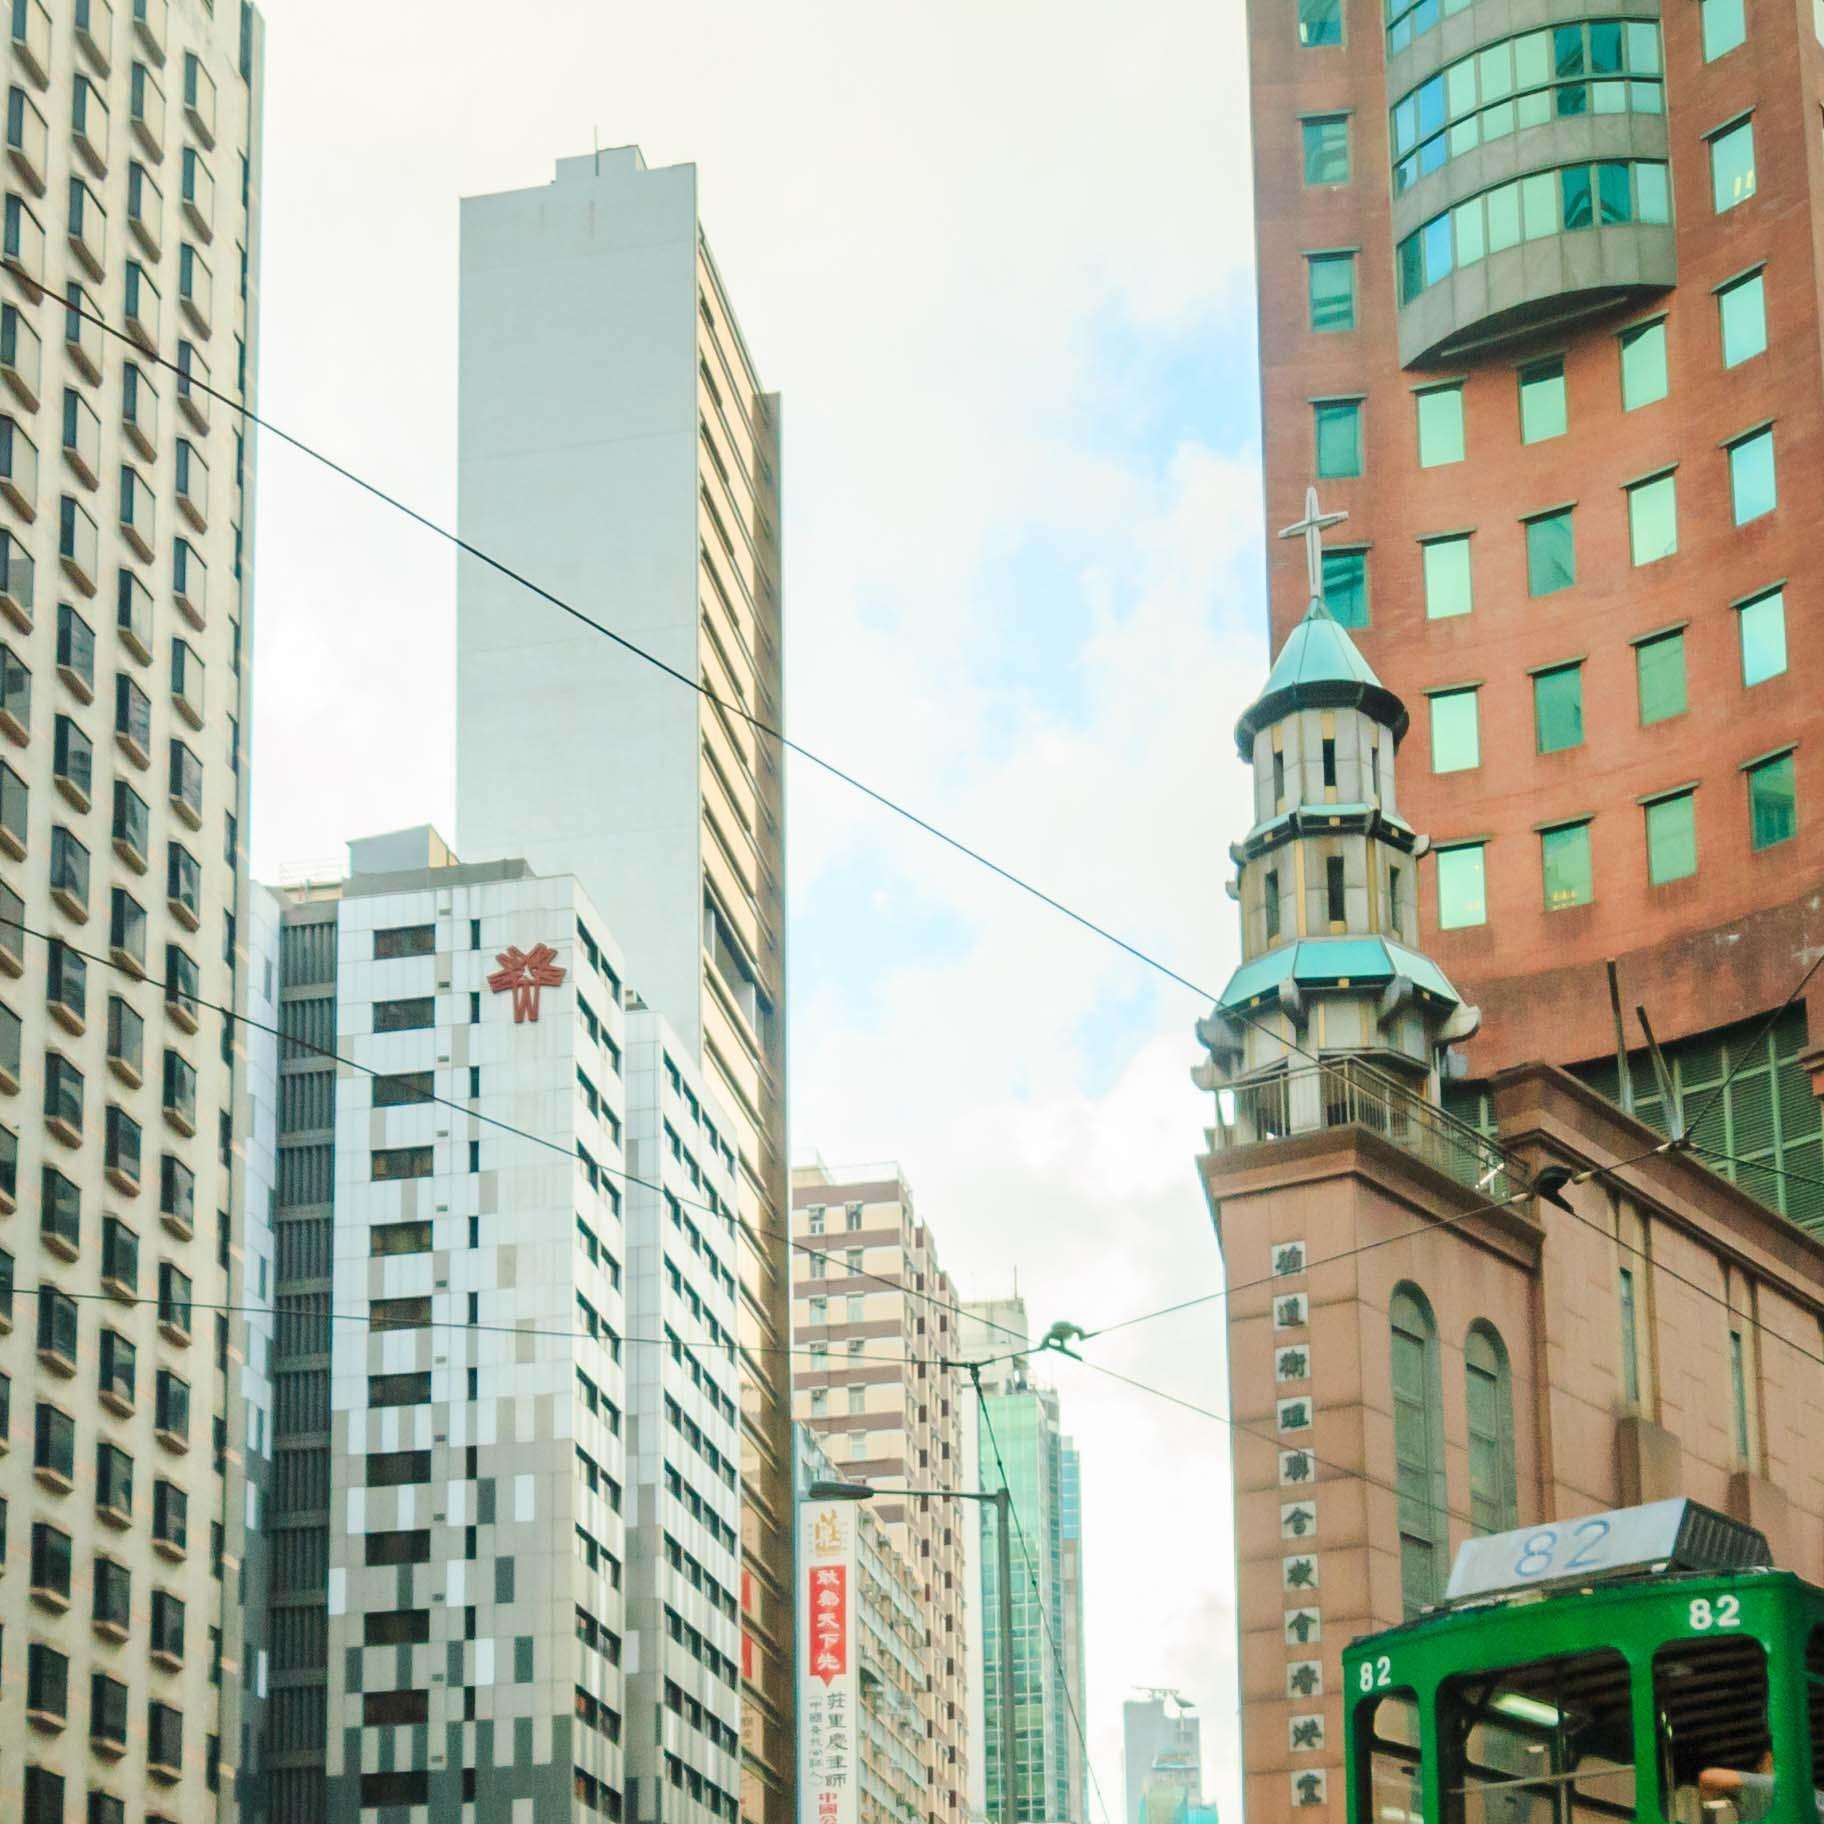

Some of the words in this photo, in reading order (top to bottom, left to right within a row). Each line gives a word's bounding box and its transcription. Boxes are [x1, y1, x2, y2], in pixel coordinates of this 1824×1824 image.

[1513, 1518, 1612, 1578] 82
[1688, 1594, 1742, 1631] 82
[1358, 1655, 1393, 1693] 82
